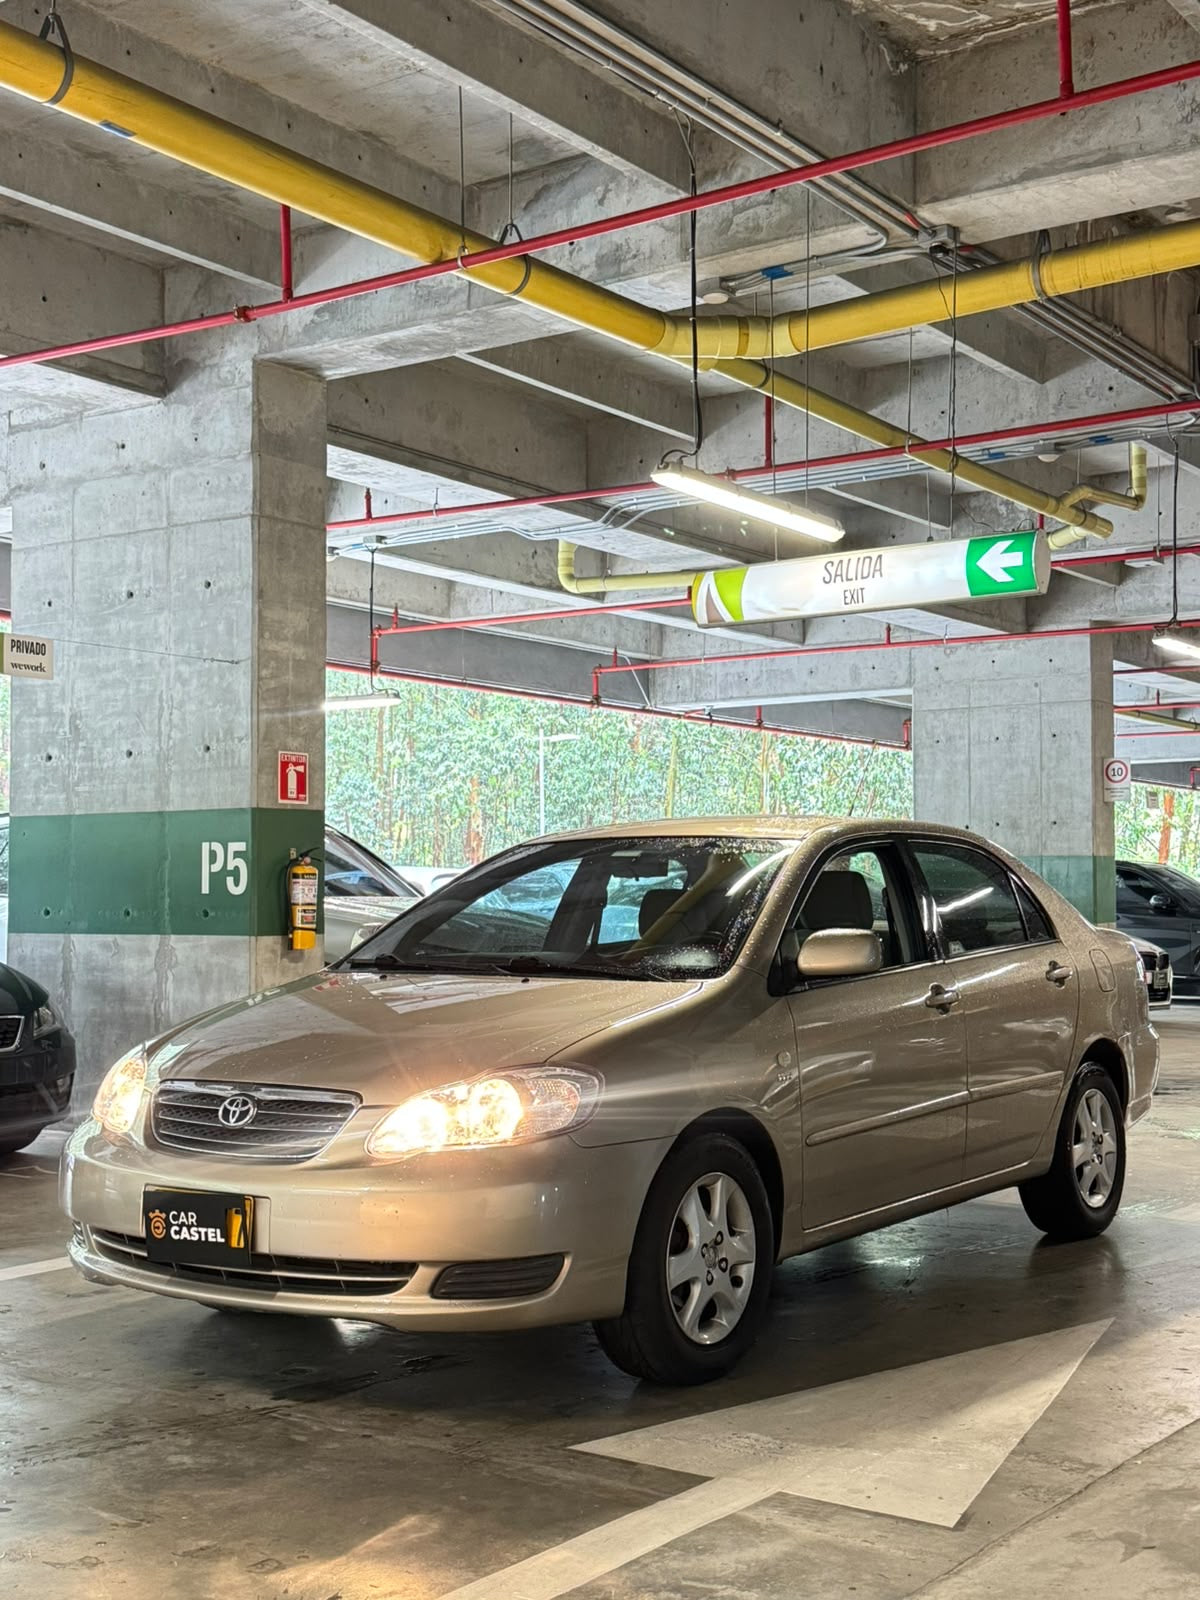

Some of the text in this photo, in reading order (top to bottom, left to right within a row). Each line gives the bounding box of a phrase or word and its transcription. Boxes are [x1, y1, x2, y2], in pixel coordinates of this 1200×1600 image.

[822, 554, 884, 584] SALIDA
[843, 587, 865, 606] EXIT
[10, 638, 47, 656] PRIVADO
[10, 662, 47, 673] wework
[1111, 767, 1124, 777] 10
[201, 841, 248, 896] P5
[169, 1210, 198, 1226] CAR
[170, 1225, 226, 1243] CASTEL
